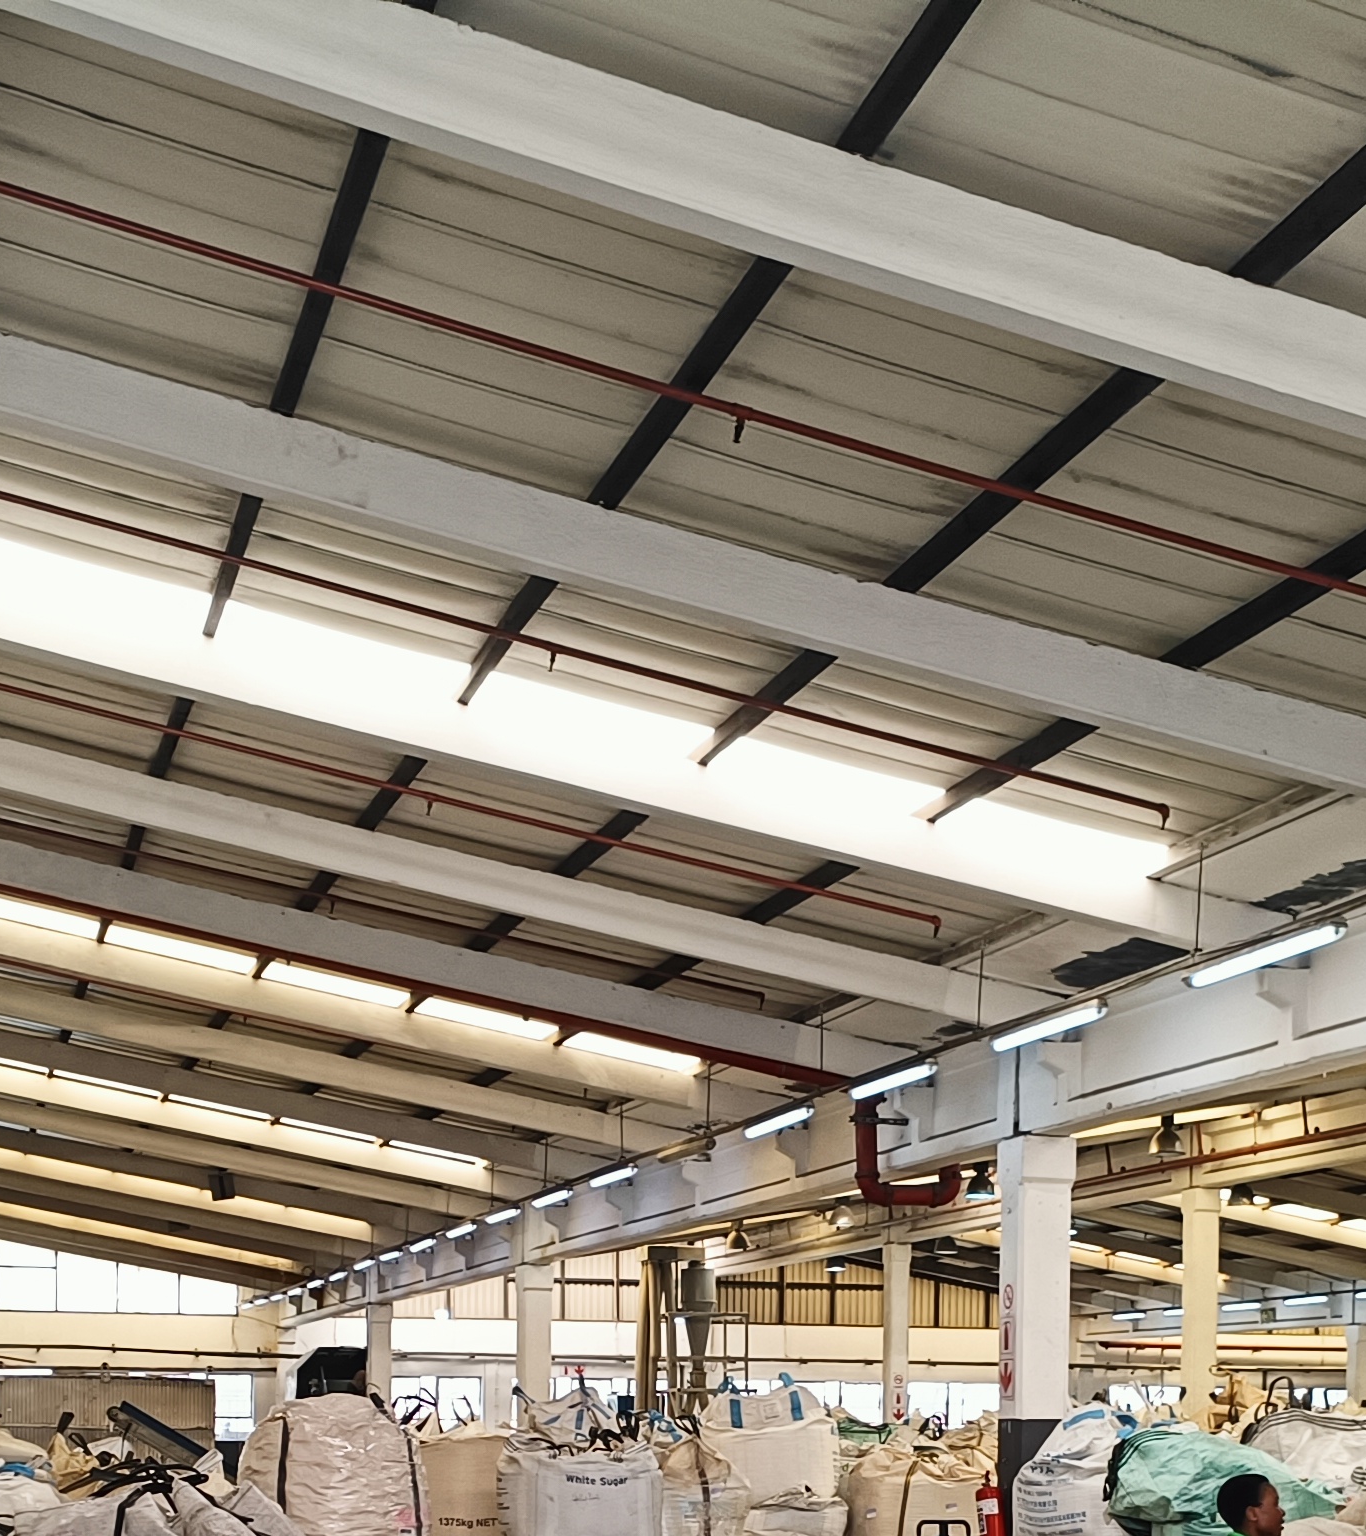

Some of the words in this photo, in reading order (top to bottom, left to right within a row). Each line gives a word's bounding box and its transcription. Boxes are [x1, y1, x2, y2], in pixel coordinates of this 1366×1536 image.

[565, 1474, 596, 1485] White
[600, 1477, 628, 1487] Sugar
[438, 1517, 474, 1529] 1375kg
